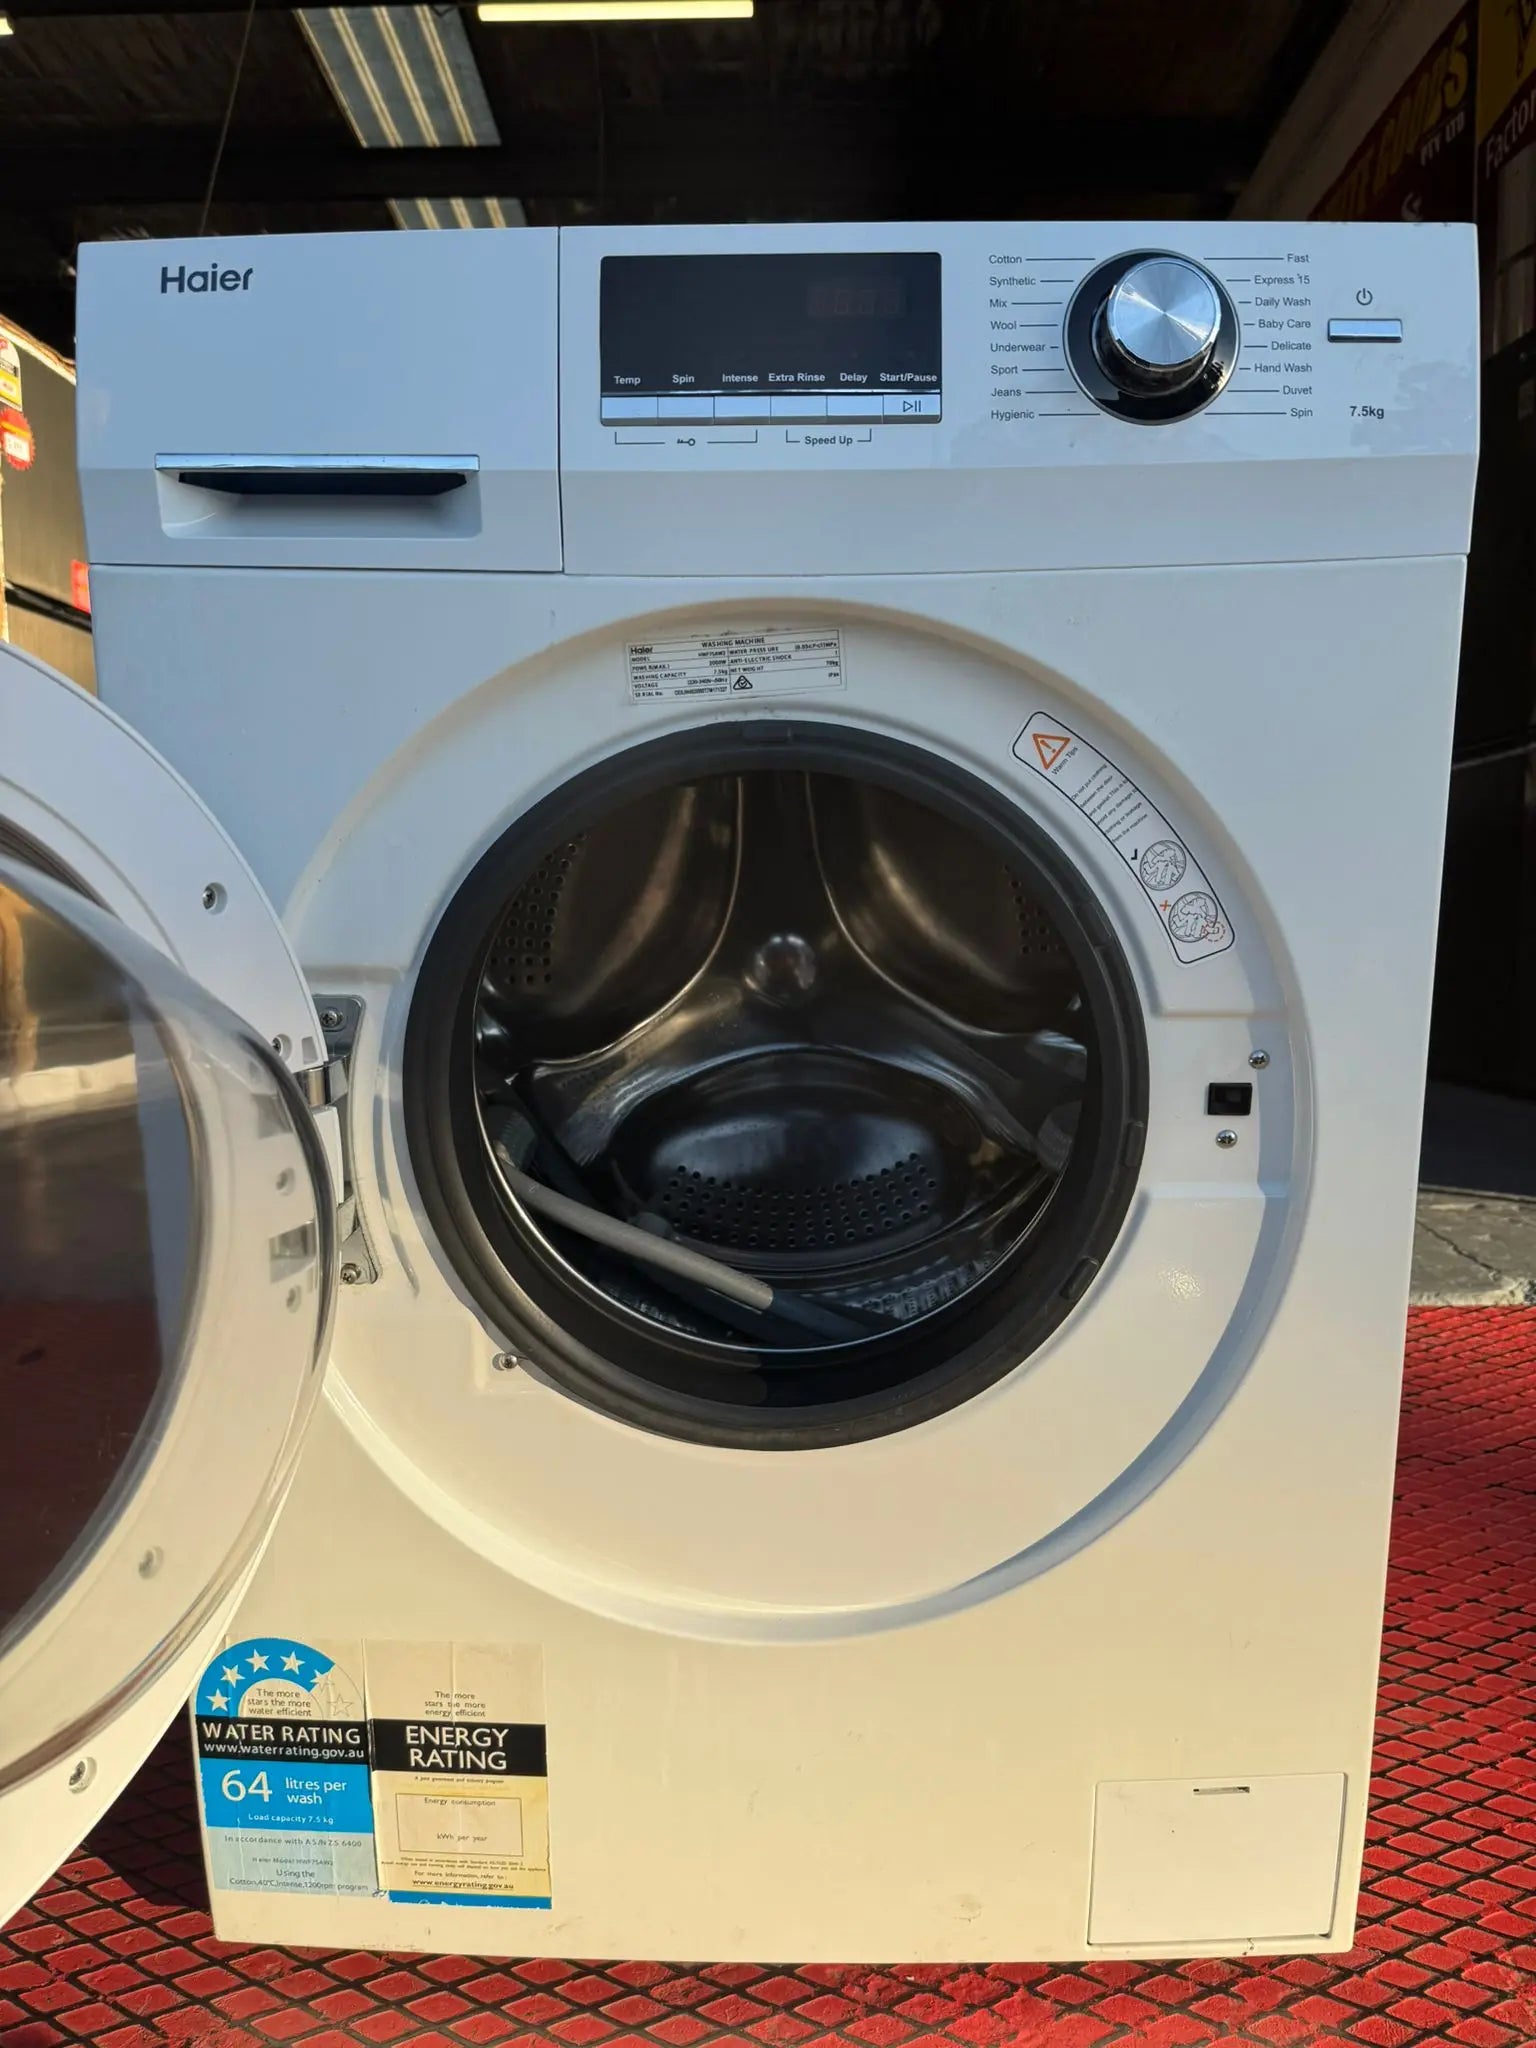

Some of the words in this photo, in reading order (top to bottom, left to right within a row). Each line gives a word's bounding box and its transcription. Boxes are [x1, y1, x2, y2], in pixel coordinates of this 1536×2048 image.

[989, 254, 1022, 265] Cotton
[1287, 254, 1309, 263] Fast
[161, 263, 253, 293] Haier
[989, 275, 1036, 288] Synthetic
[1254, 275, 1294, 287] Express
[990, 298, 1007, 308] Mix
[1255, 296, 1283, 309] Daily
[1285, 296, 1311, 307] Wash
[990, 320, 1017, 330] Wool
[1258, 318, 1284, 331] Baby
[1286, 318, 1311, 329] Care
[990, 342, 1045, 353] Underwear
[1271, 341, 1312, 351] Delicate
[991, 364, 1018, 377] Sport
[1255, 363, 1280, 374] Hand
[1284, 363, 1312, 373] Wash
[614, 376, 641, 386] Temp
[672, 374, 695, 384] Spin
[722, 373, 758, 383] Intense
[768, 373, 795, 382] Extra
[797, 373, 825, 382] Rinse
[840, 372, 867, 384] Delay
[880, 372, 937, 383] Start/Pause
[991, 387, 1021, 397] Jeans
[1282, 385, 1312, 395] Duvet
[991, 409, 1035, 422] Hygienic
[1290, 407, 1313, 420] Spin
[1350, 406, 1384, 420] 7.5kg
[804, 436, 836, 447] Speed
[839, 436, 853, 447] Up
[630, 646, 654, 654] Haier
[1052, 758, 1069, 775] Warm
[1066, 747, 1078, 758] Tips
[257, 1688, 273, 1697] The
[276, 1690, 300, 1698] more
[248, 1698, 269, 1707] stars
[271, 1698, 285, 1707] the
[287, 1700, 311, 1708] more
[249, 1707, 273, 1716] water
[276, 1707, 312, 1716] efficient
[425, 1709, 451, 1717] energy
[202, 1722, 274, 1742] WATER
[282, 1726, 360, 1744] RATING
[406, 1725, 509, 1748] ENERGY
[204, 1742, 364, 1759] www.waterrating.gov.au
[410, 1748, 507, 1770] RATING
[222, 1769, 272, 1803] 64
[285, 1777, 320, 1790] litres
[324, 1780, 347, 1794] per
[287, 1792, 322, 1805] wash
[425, 1797, 447, 1806] Energy
[451, 1798, 496, 1807] consumption
[248, 1814, 269, 1822] Load
[271, 1814, 306, 1824] capacity
[323, 1816, 334, 1825] kg
[236, 1836, 282, 1845] accordance
[285, 1837, 301, 1845] with
[342, 1840, 362, 1848] 6400
[473, 1835, 487, 1843] year
[276, 1869, 300, 1879] Using
[338, 1883, 368, 1892] program
